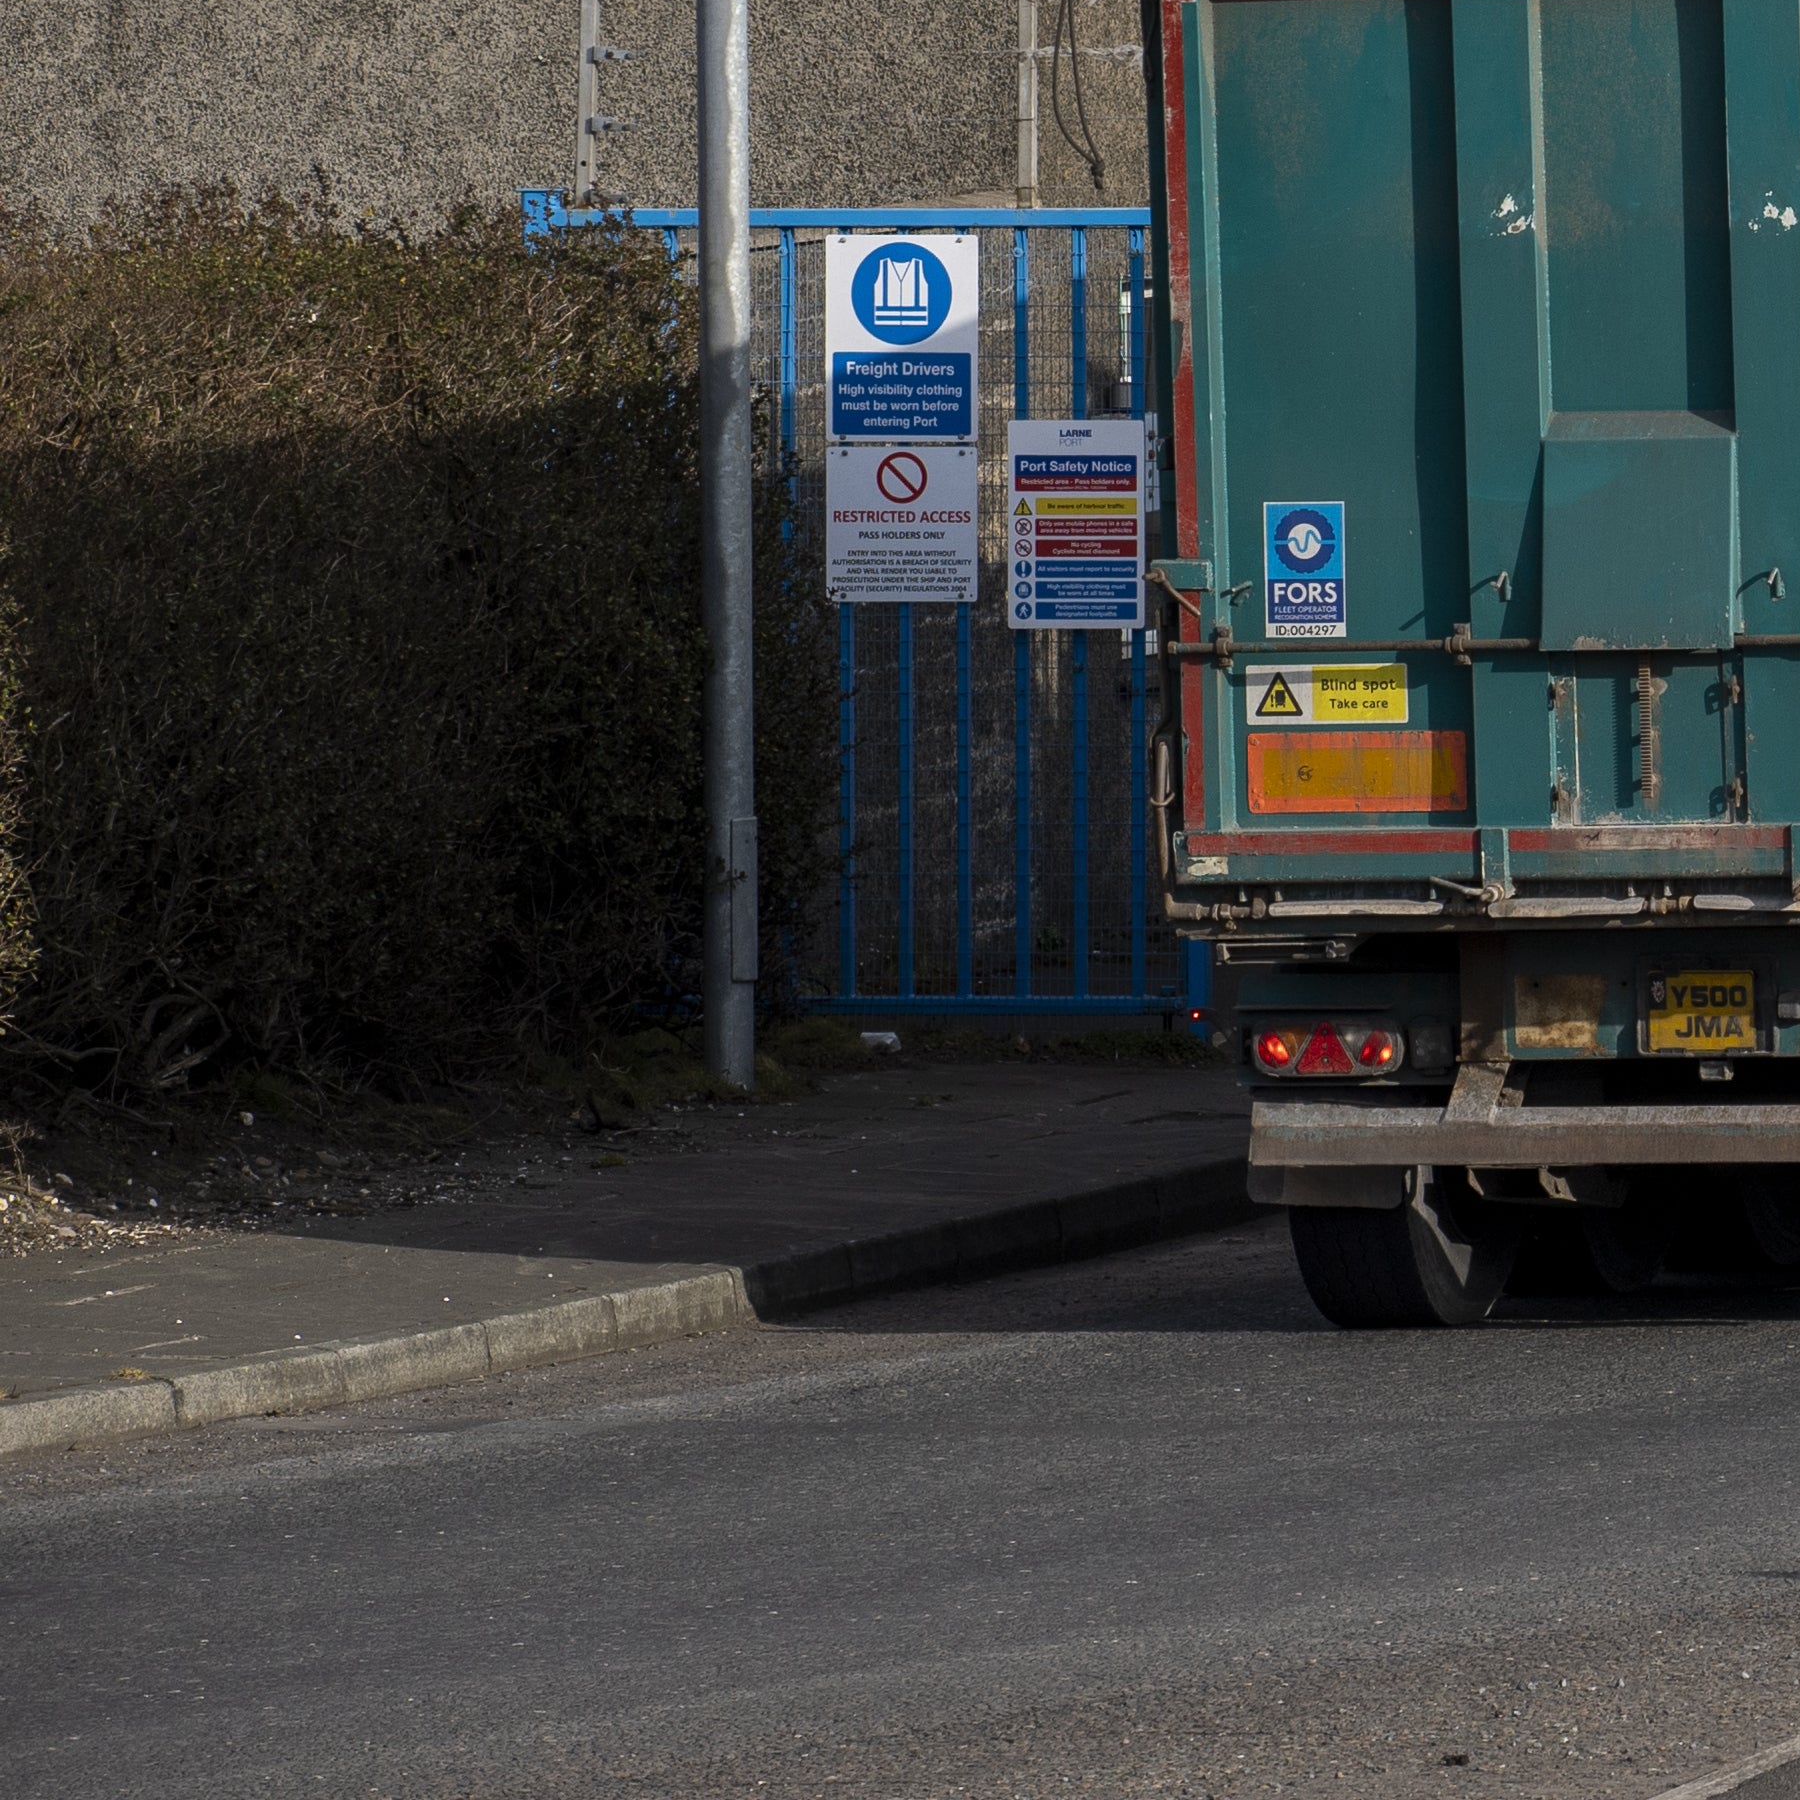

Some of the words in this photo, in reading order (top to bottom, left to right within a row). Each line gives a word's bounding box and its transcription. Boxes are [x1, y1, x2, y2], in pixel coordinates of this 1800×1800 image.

[846, 360, 898, 378] Freight
[902, 361, 955, 376] Drivers
[838, 384, 865, 398] High
[868, 384, 914, 398] visibility
[916, 384, 962, 398] clothing
[841, 400, 870, 411] must
[873, 400, 888, 411] be
[890, 402, 920, 411] worn
[922, 400, 959, 412] before
[863, 416, 910, 429] entering
[913, 416, 938, 427] Port
[1059, 429, 1092, 438] LARNE
[1059, 438, 1082, 448] PORT
[1020, 460, 1046, 472] Port
[1049, 460, 1089, 474] Safety
[1092, 460, 1132, 472] Notice
[833, 510, 916, 523] RESTRICTED
[919, 510, 971, 523] ACCESS
[858, 530, 880, 540] PASS
[881, 530, 921, 540] HOLDERS
[922, 531, 945, 540] ONLY
[1274, 582, 1337, 604] FORS
[1274, 606, 1296, 614] FLEET
[1297, 605, 1338, 614] OPERATOR
[1275, 624, 1337, 636] ID:004297
[1321, 679, 1357, 691] Blind
[1363, 679, 1397, 693] spot
[1328, 698, 1358, 709] Take
[1362, 700, 1388, 709] care
[1671, 985, 1748, 1008] Y500
[1675, 1016, 1744, 1038] JMA
